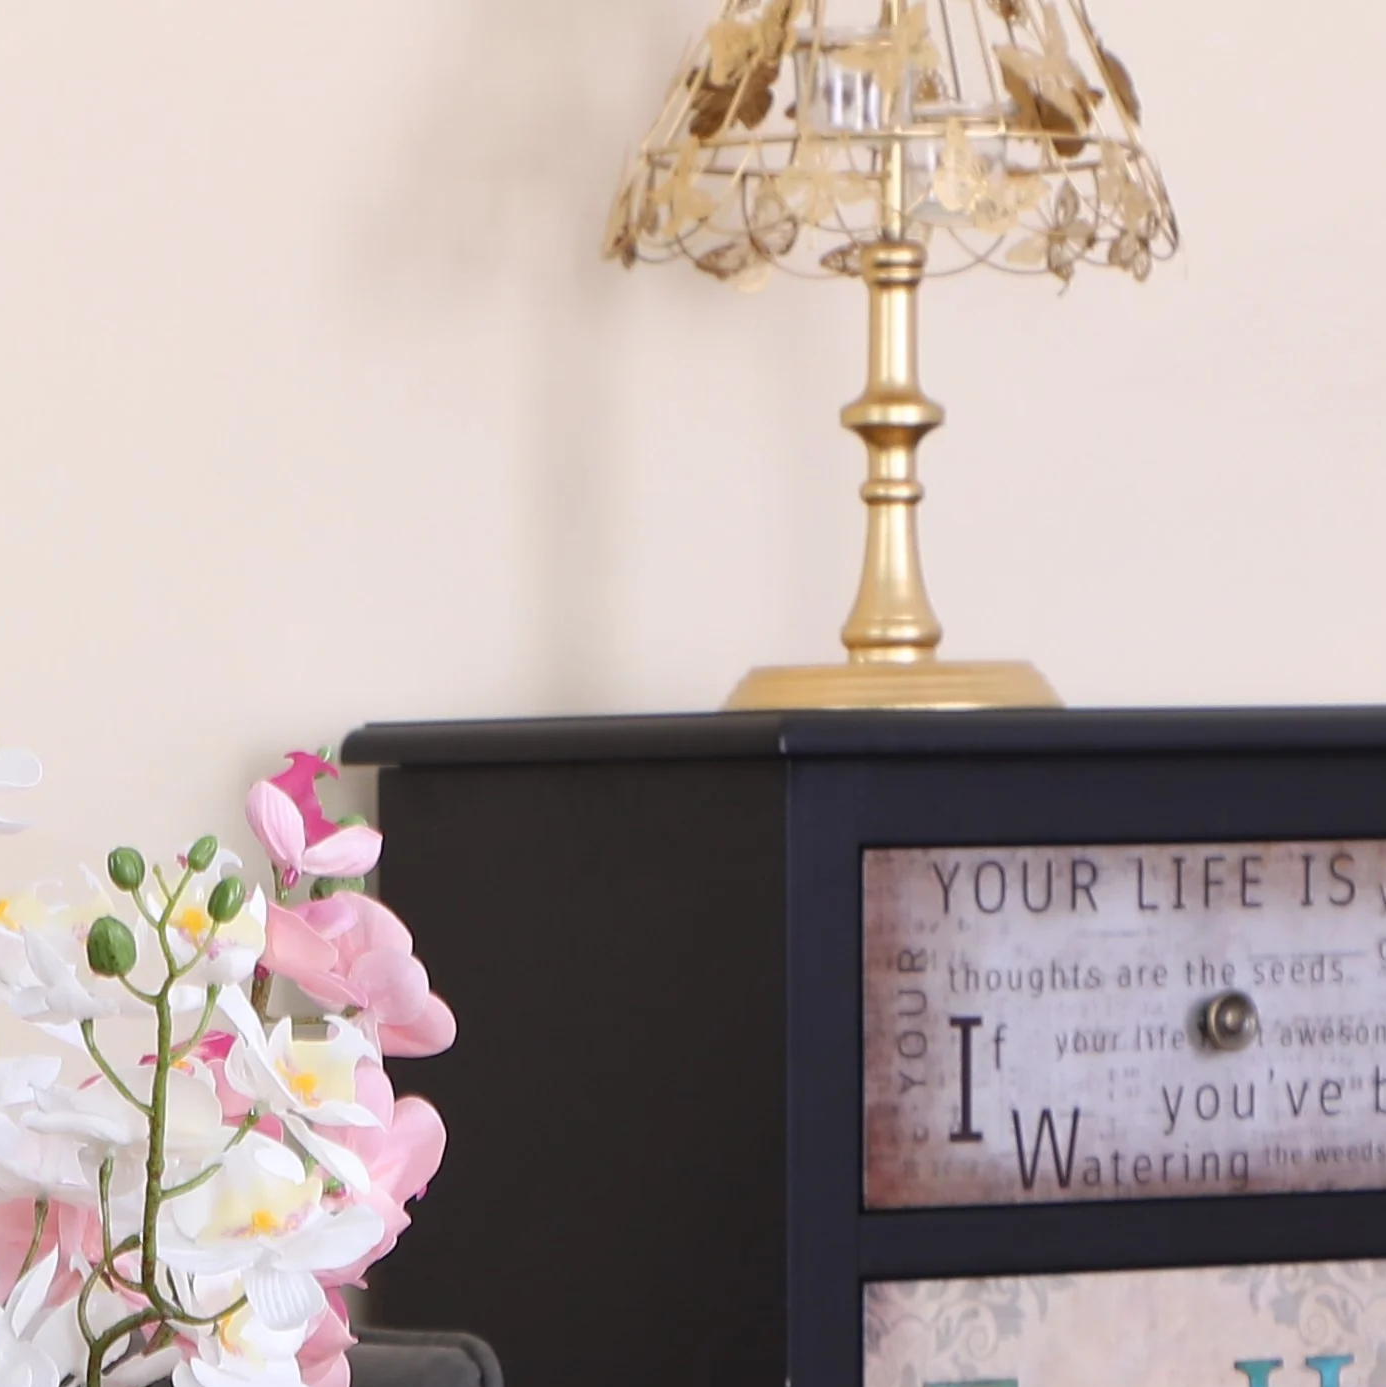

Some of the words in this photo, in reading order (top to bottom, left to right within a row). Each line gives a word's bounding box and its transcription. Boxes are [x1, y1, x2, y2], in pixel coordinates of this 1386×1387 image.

[931, 859, 1099, 914] YOUR
[1135, 855, 1262, 911] LIFE
[1300, 852, 1356, 907] IS
[948, 960, 1101, 998] thoughts
[1116, 965, 1166, 988] are
[1185, 956, 1236, 986] the
[896, 947, 928, 1094] YOUR
[1135, 1021, 1186, 1049] life
[948, 1016, 1007, 1142] If
[1162, 1066, 1342, 1136] you've
[1012, 1105, 1249, 1189] Watering
[1266, 1142, 1301, 1166] the
